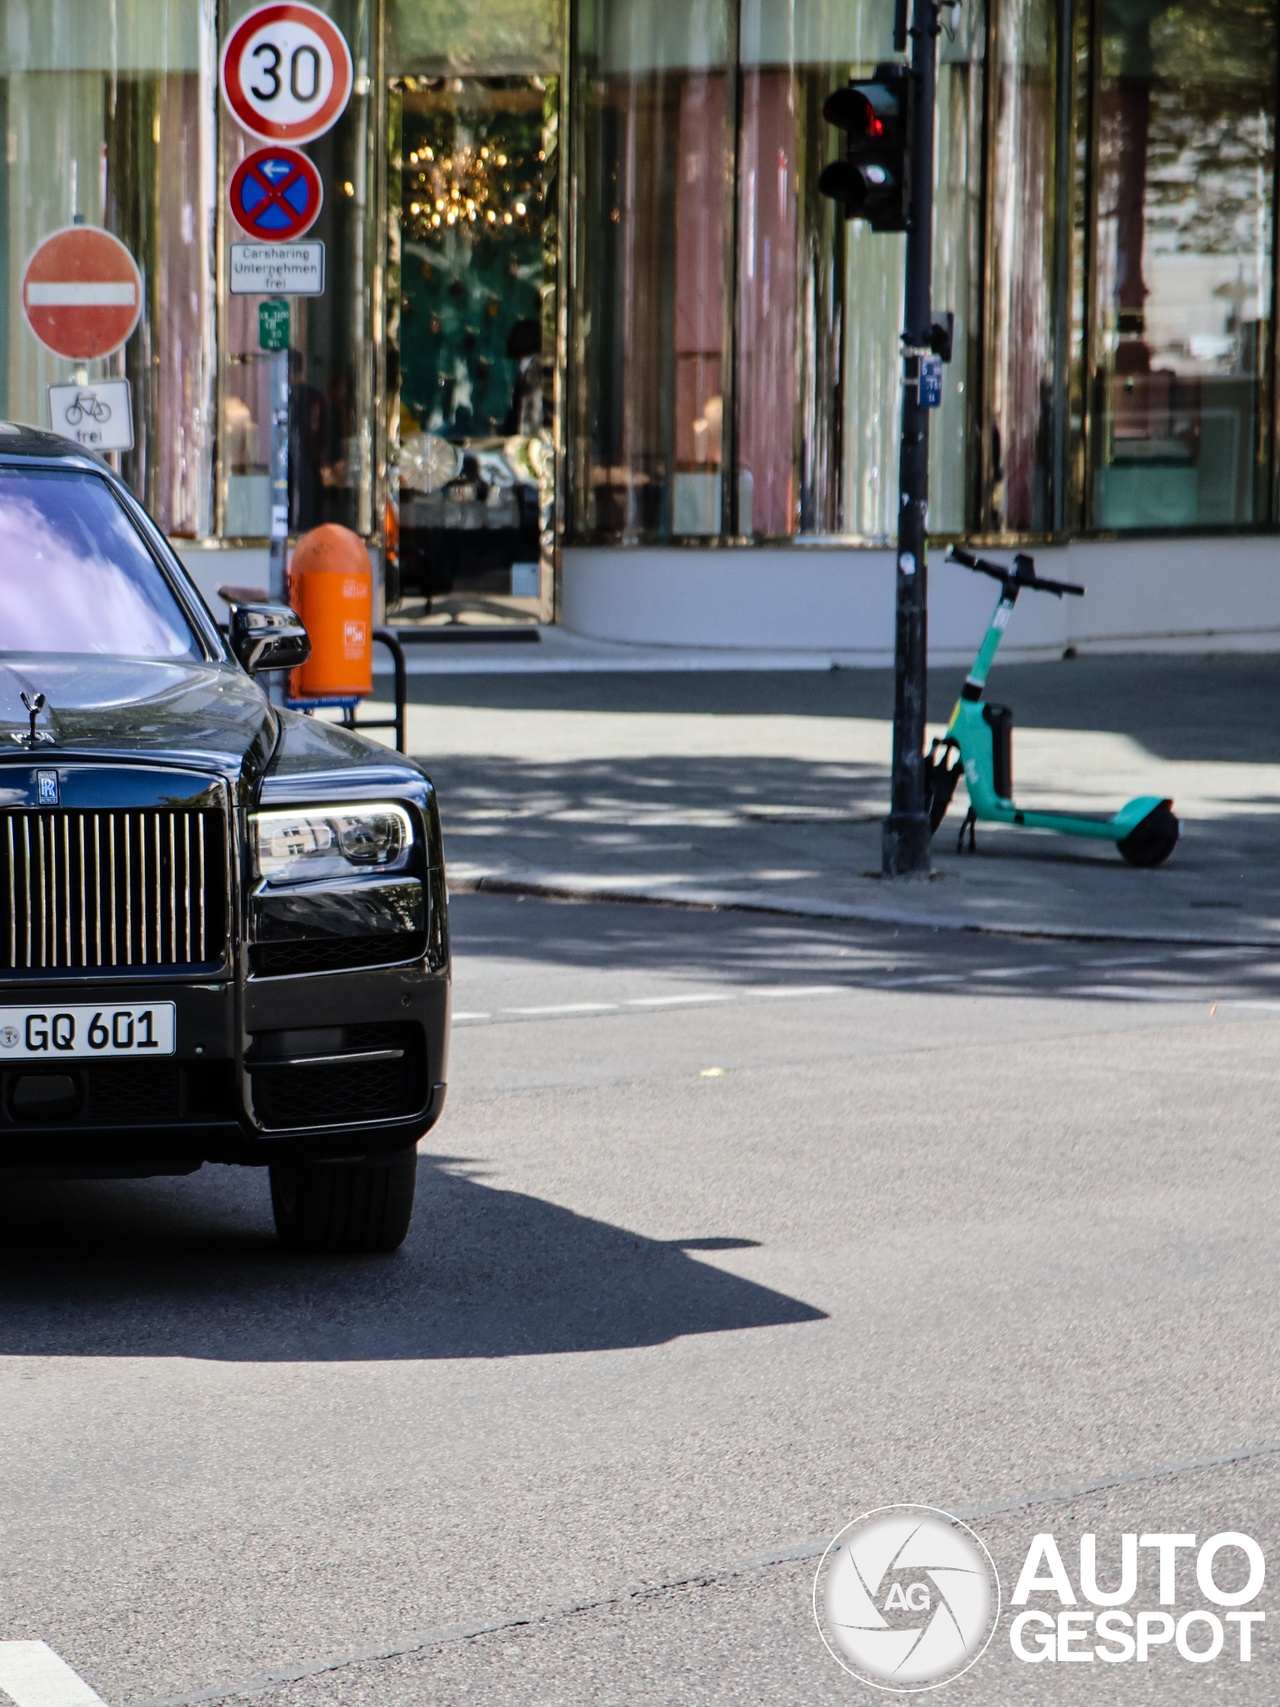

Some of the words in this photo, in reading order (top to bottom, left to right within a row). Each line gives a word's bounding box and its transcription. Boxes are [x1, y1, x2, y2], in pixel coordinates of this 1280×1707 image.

[251, 42, 321, 102] 30
[243, 248, 310, 261] Carsharing
[234, 263, 318, 275] Unternehmen
[266, 278, 287, 289] frei
[76, 428, 103, 443] frei
[25, 1013, 75, 1052] GQ
[87, 1010, 159, 1050] 601
